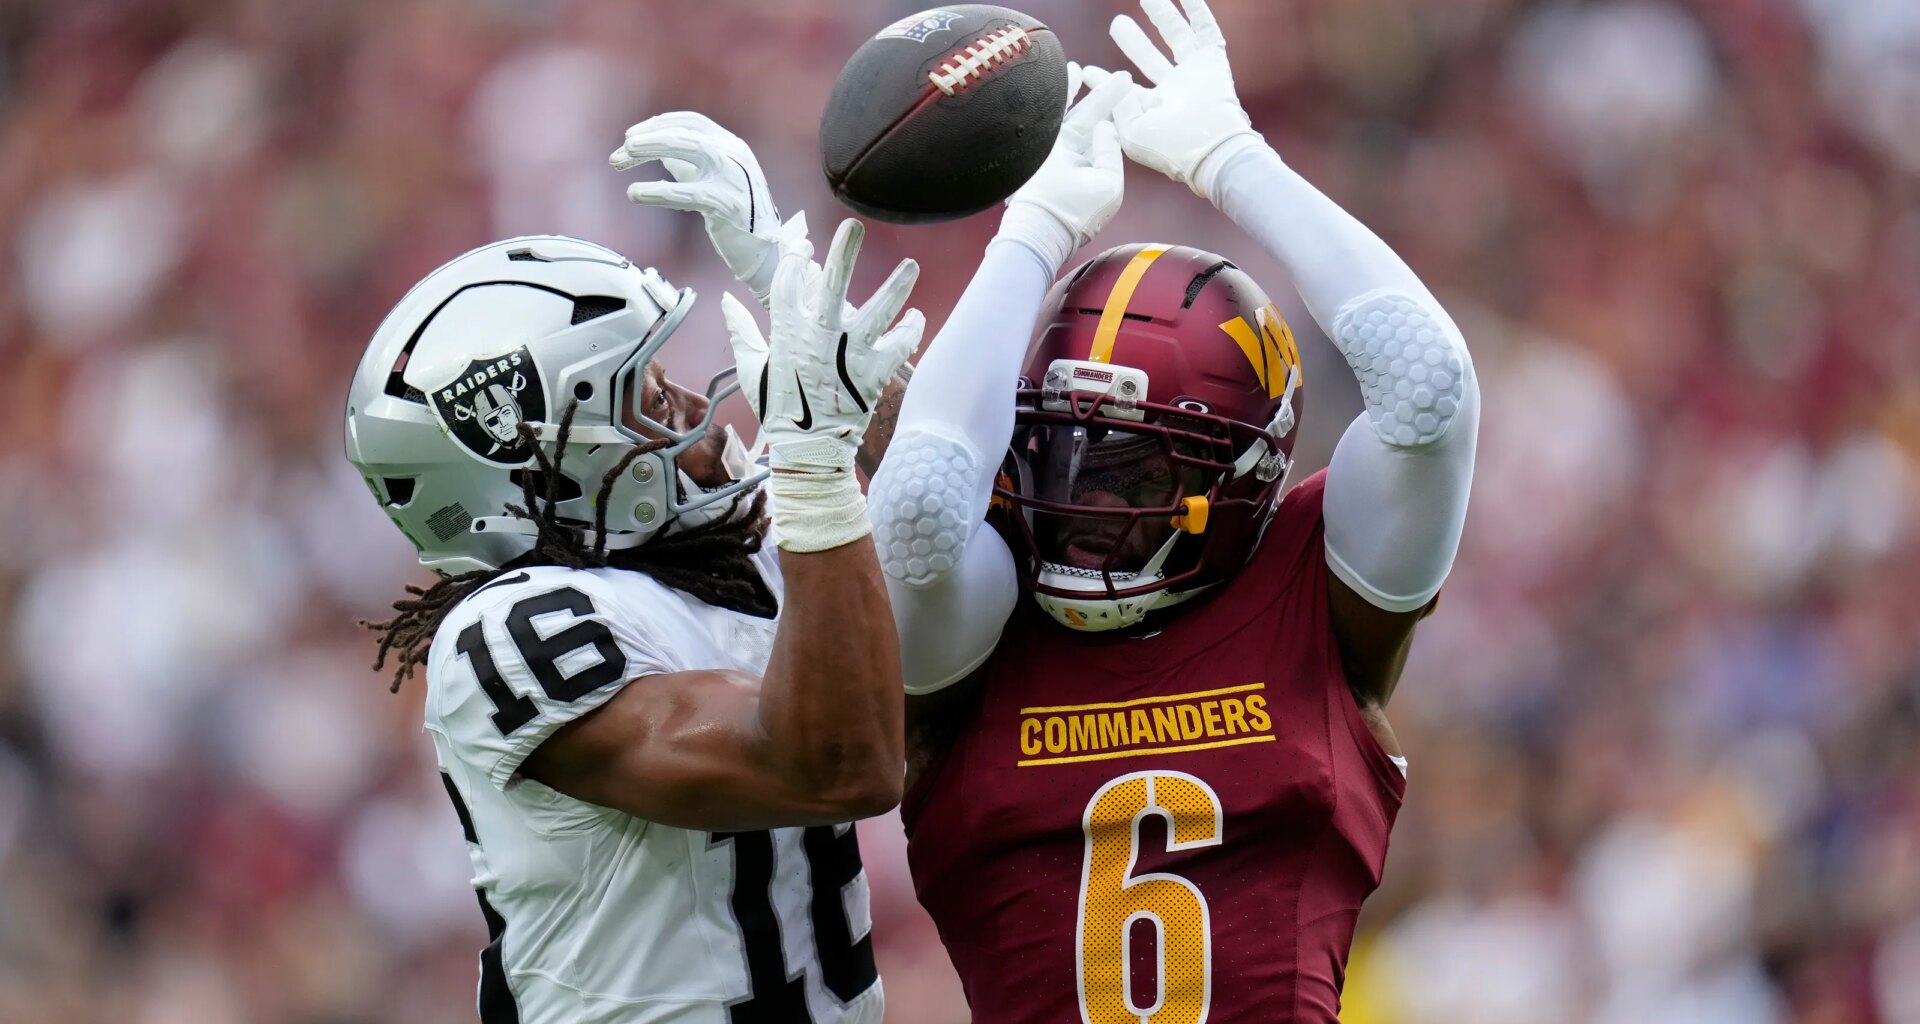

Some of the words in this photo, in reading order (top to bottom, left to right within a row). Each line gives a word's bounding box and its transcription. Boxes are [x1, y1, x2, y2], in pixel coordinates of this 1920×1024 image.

[442, 353, 522, 402] RAIDERS
[1073, 369, 1114, 382] COMMANDERS
[455, 585, 630, 738] 16
[1020, 694, 1273, 756] COMMANDERS
[705, 825, 880, 1024] 16
[1075, 770, 1223, 1024] 6
